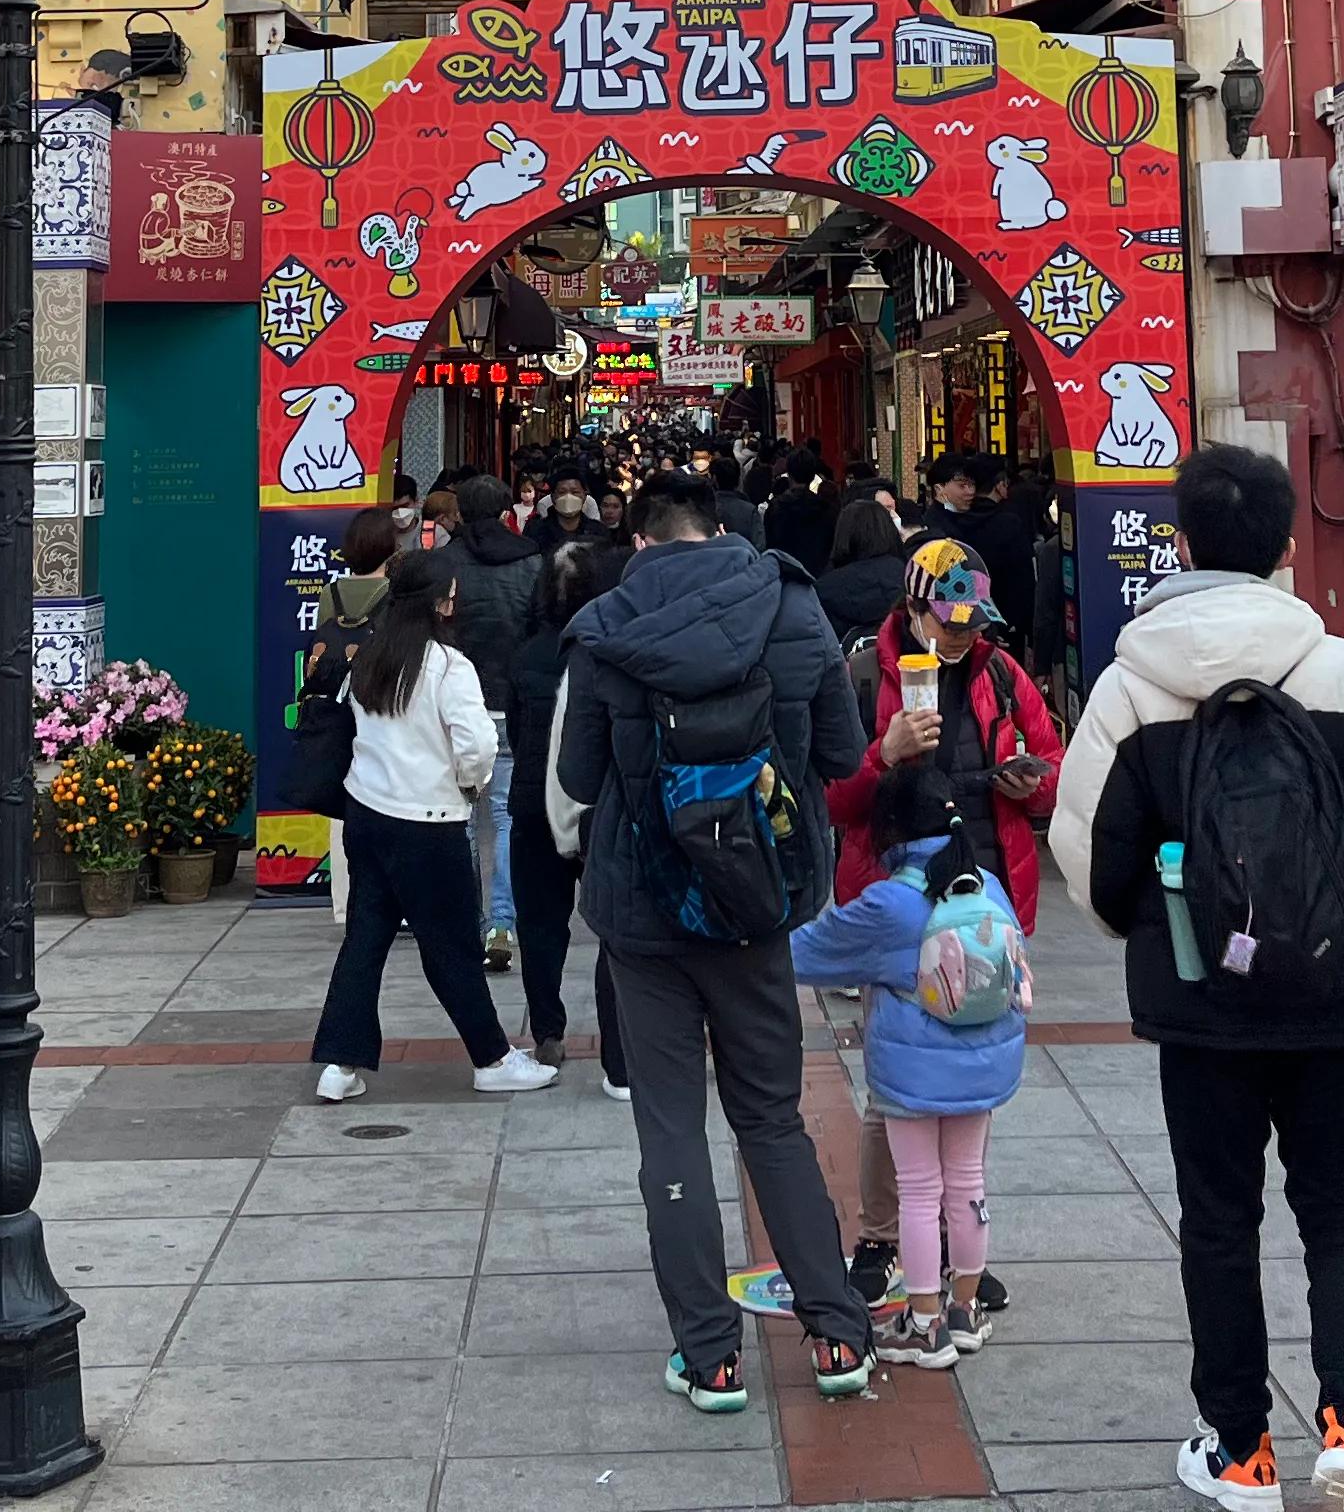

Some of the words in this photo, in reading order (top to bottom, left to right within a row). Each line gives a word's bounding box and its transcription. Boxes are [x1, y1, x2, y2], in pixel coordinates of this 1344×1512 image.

[676, 8, 737, 26] TAIPA
[555, 1, 880, 110] 悠氹仔
[167, 141, 218, 157] 澳門特產
[730, 310, 806, 334] 老酸奶
[1119, 560, 1147, 570] TAIPA
